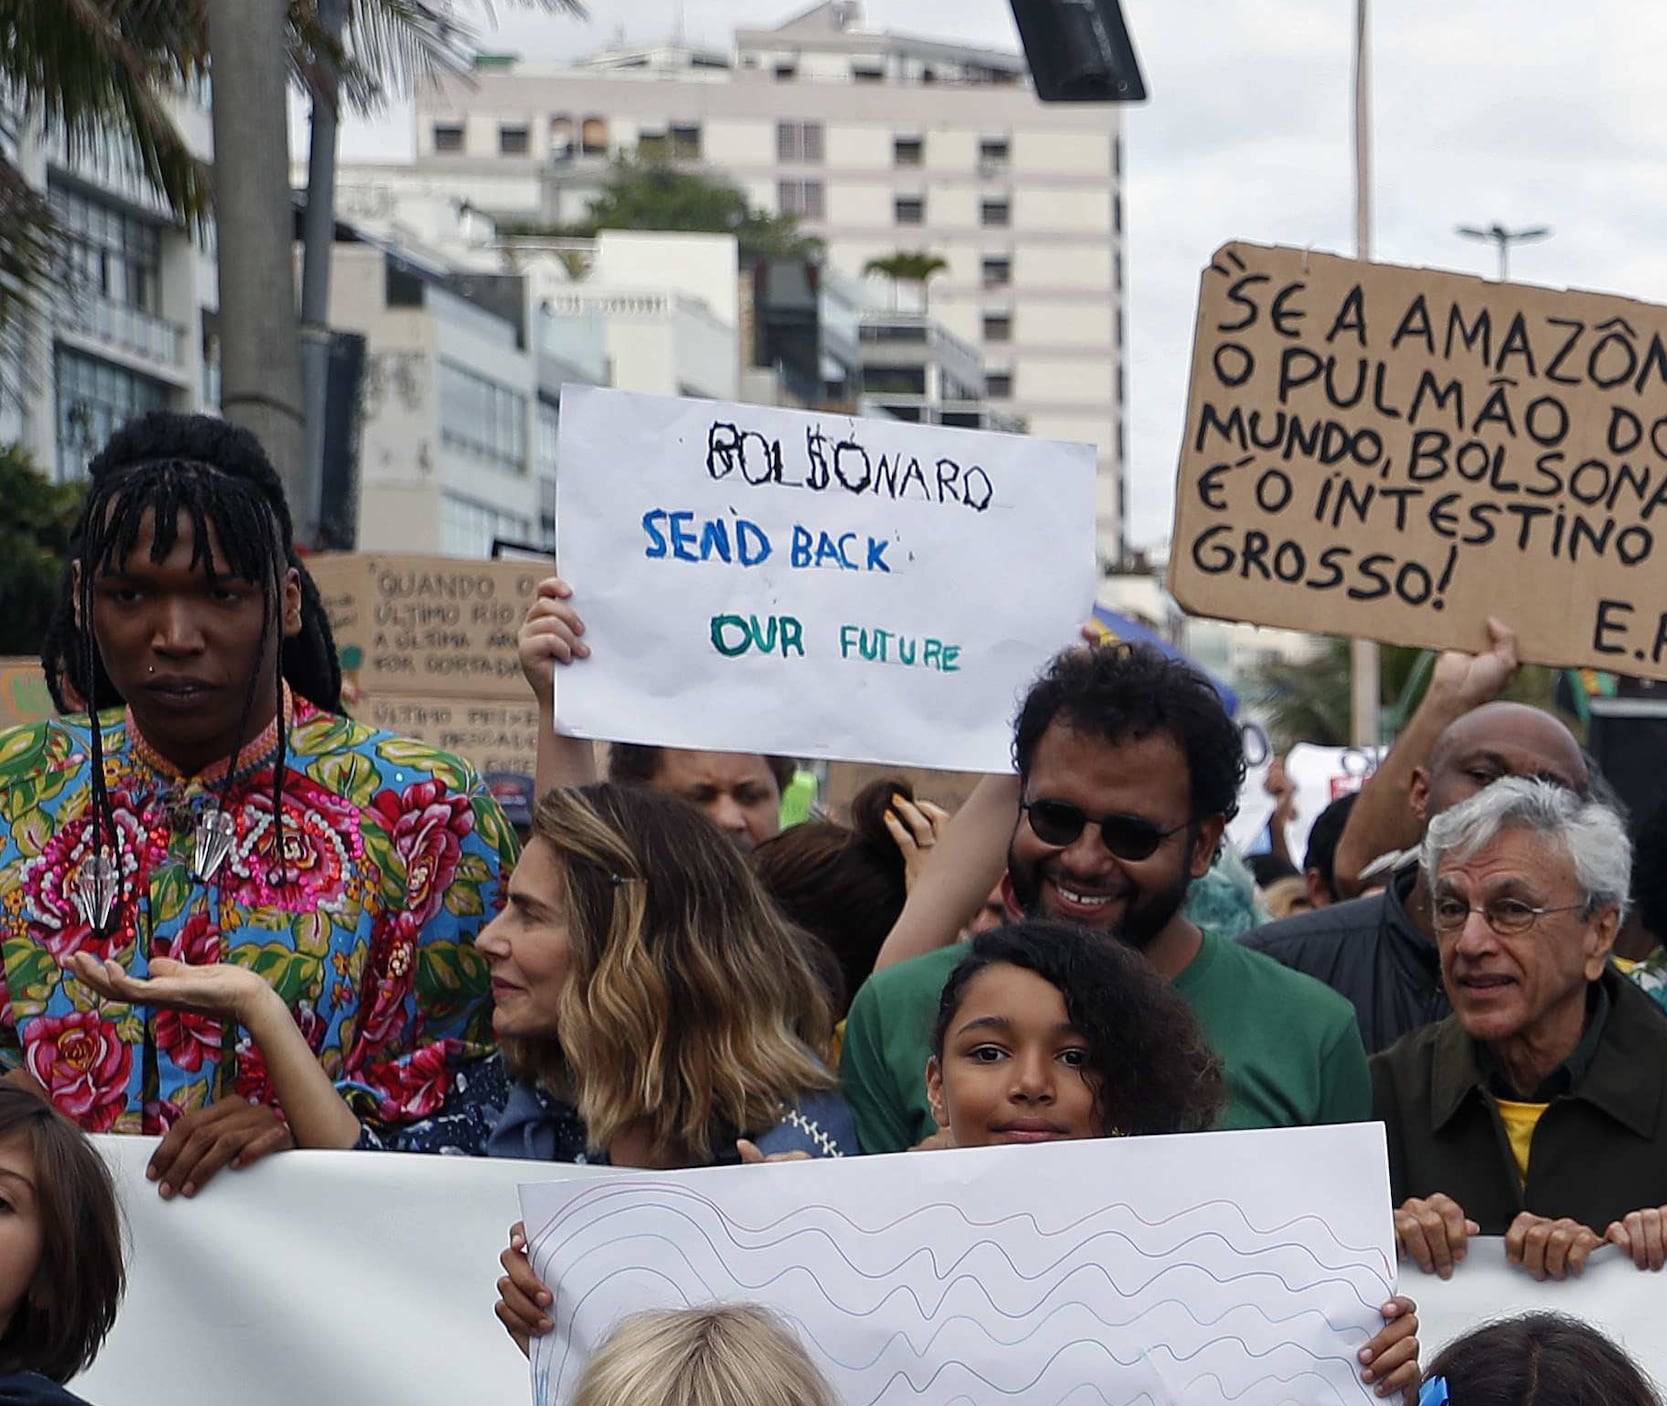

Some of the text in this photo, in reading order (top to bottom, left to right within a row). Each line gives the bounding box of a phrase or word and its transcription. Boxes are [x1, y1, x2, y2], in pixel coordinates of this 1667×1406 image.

[1325, 285, 1368, 348] A
[1213, 343, 1254, 386] O
[1280, 347, 1570, 447] PULMÃO
[1196, 404, 1391, 477] MUNDO,
[643, 508, 891, 573] SEND BACK
[1199, 456, 1653, 565] É O INTESTINO
[1193, 525, 1459, 611] GROSSO!
[711, 614, 962, 672] OUR FUTURE
